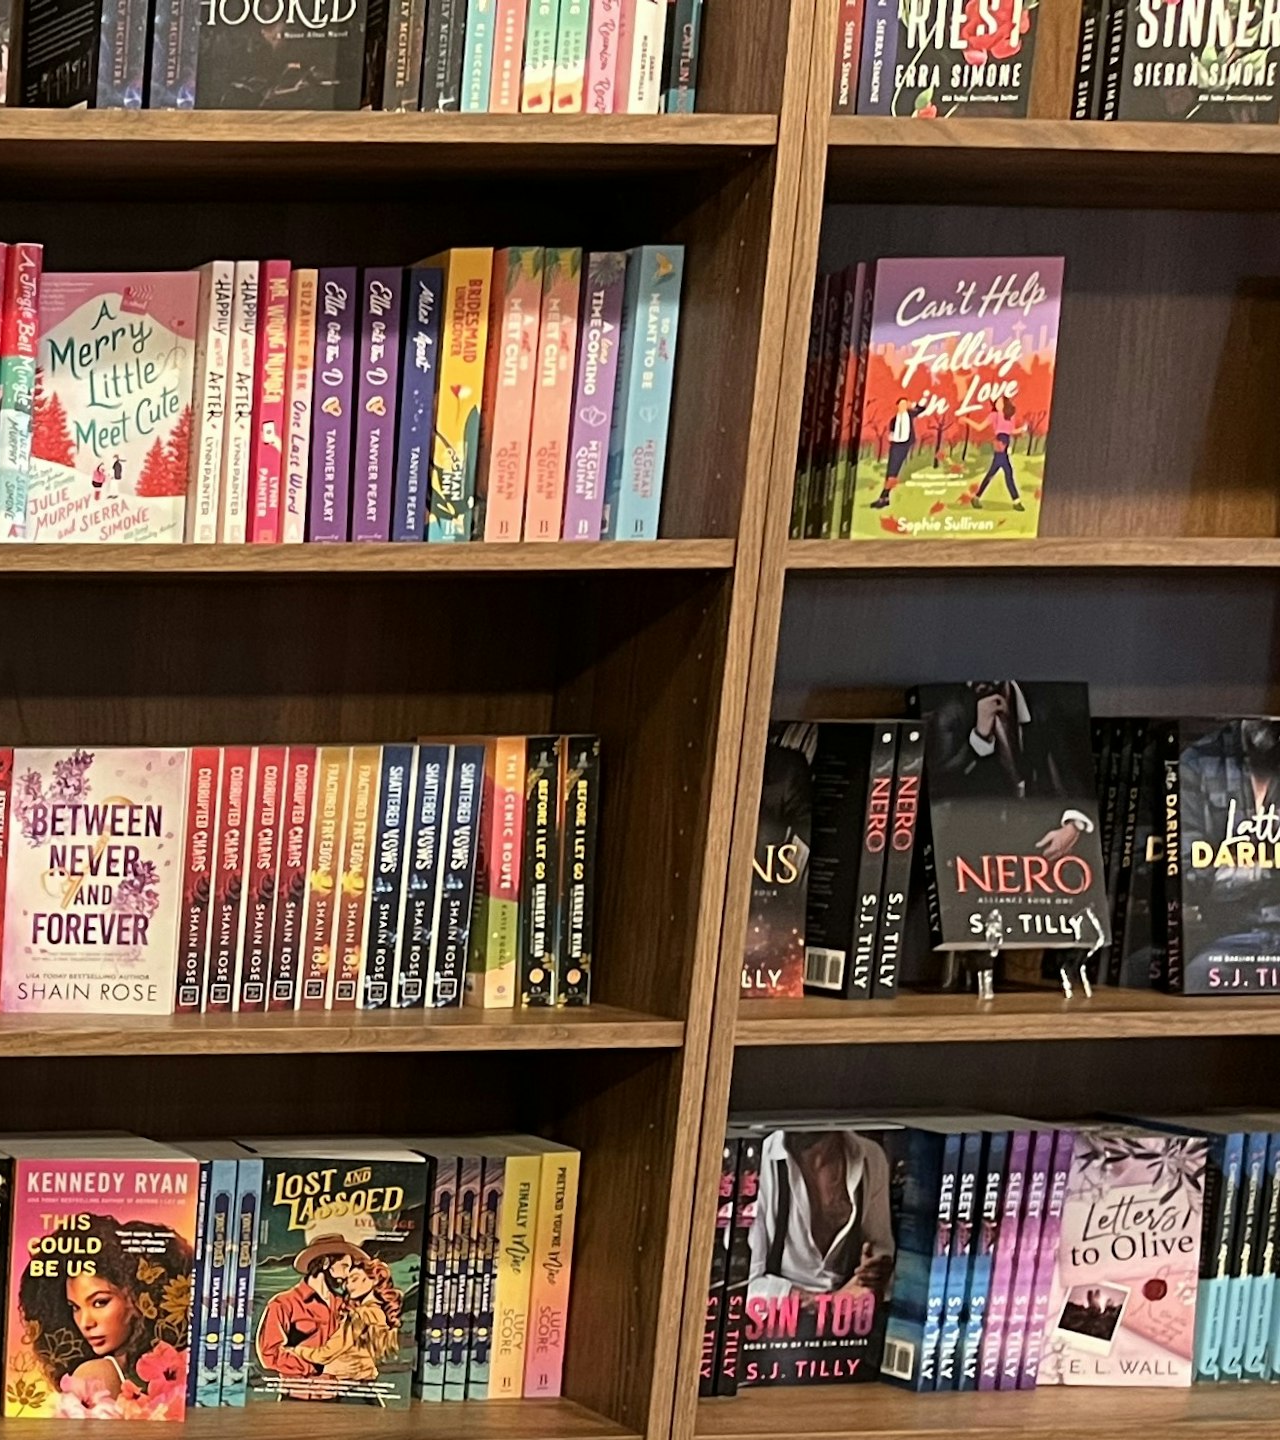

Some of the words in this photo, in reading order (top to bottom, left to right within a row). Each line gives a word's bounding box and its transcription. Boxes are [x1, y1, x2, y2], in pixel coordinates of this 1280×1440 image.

[1133, 62, 1199, 88] SIERRA
[1209, 63, 1277, 88] SIMONE
[93, 301, 115, 330] A
[897, 279, 972, 328] Can't
[981, 272, 1047, 315] Help
[48, 323, 152, 377] Merry
[904, 334, 1022, 387] Falling
[89, 366, 156, 407] Little
[918, 390, 948, 417] in
[955, 377, 1018, 416] Love
[74, 413, 130, 456] Meet
[138, 390, 179, 435] Cute
[30, 488, 70, 512] JULIE
[37, 496, 93, 530] MURPHY
[57, 521, 77, 539] and
[80, 501, 129, 528] SIERRA
[99, 510, 150, 540] SIMONE
[898, 518, 941, 533] Sophie
[945, 517, 994, 532] Sullivan
[31, 805, 162, 837] BETWEEN
[49, 845, 141, 876] NEVER
[956, 856, 1093, 894] NERO
[73, 887, 112, 906] AND
[32, 913, 149, 946] FOREVER
[18, 983, 91, 1001] SHAIN
[100, 984, 158, 1001] ROSE
[28, 1172, 123, 1193] KENNEDY
[135, 1172, 188, 1193] RYAN
[273, 1169, 338, 1206] LOST
[344, 1167, 372, 1185] AND
[41, 1214, 91, 1231] THIS
[288, 1187, 403, 1232] LASSOED
[1082, 1198, 1186, 1239] Letters
[27, 1238, 102, 1255] COULD
[1072, 1247, 1099, 1265] to
[1111, 1232, 1195, 1261] Olive
[30, 1261, 58, 1278] BE
[68, 1260, 96, 1278] US
[746, 1292, 798, 1339] SIN
[809, 1291, 874, 1338] TOO
[746, 1362, 786, 1379] S.J.
[795, 1358, 860, 1379] TILLY
[1070, 1361, 1088, 1375] E.
[1095, 1362, 1111, 1377] L.
[1121, 1361, 1179, 1376] WALL
